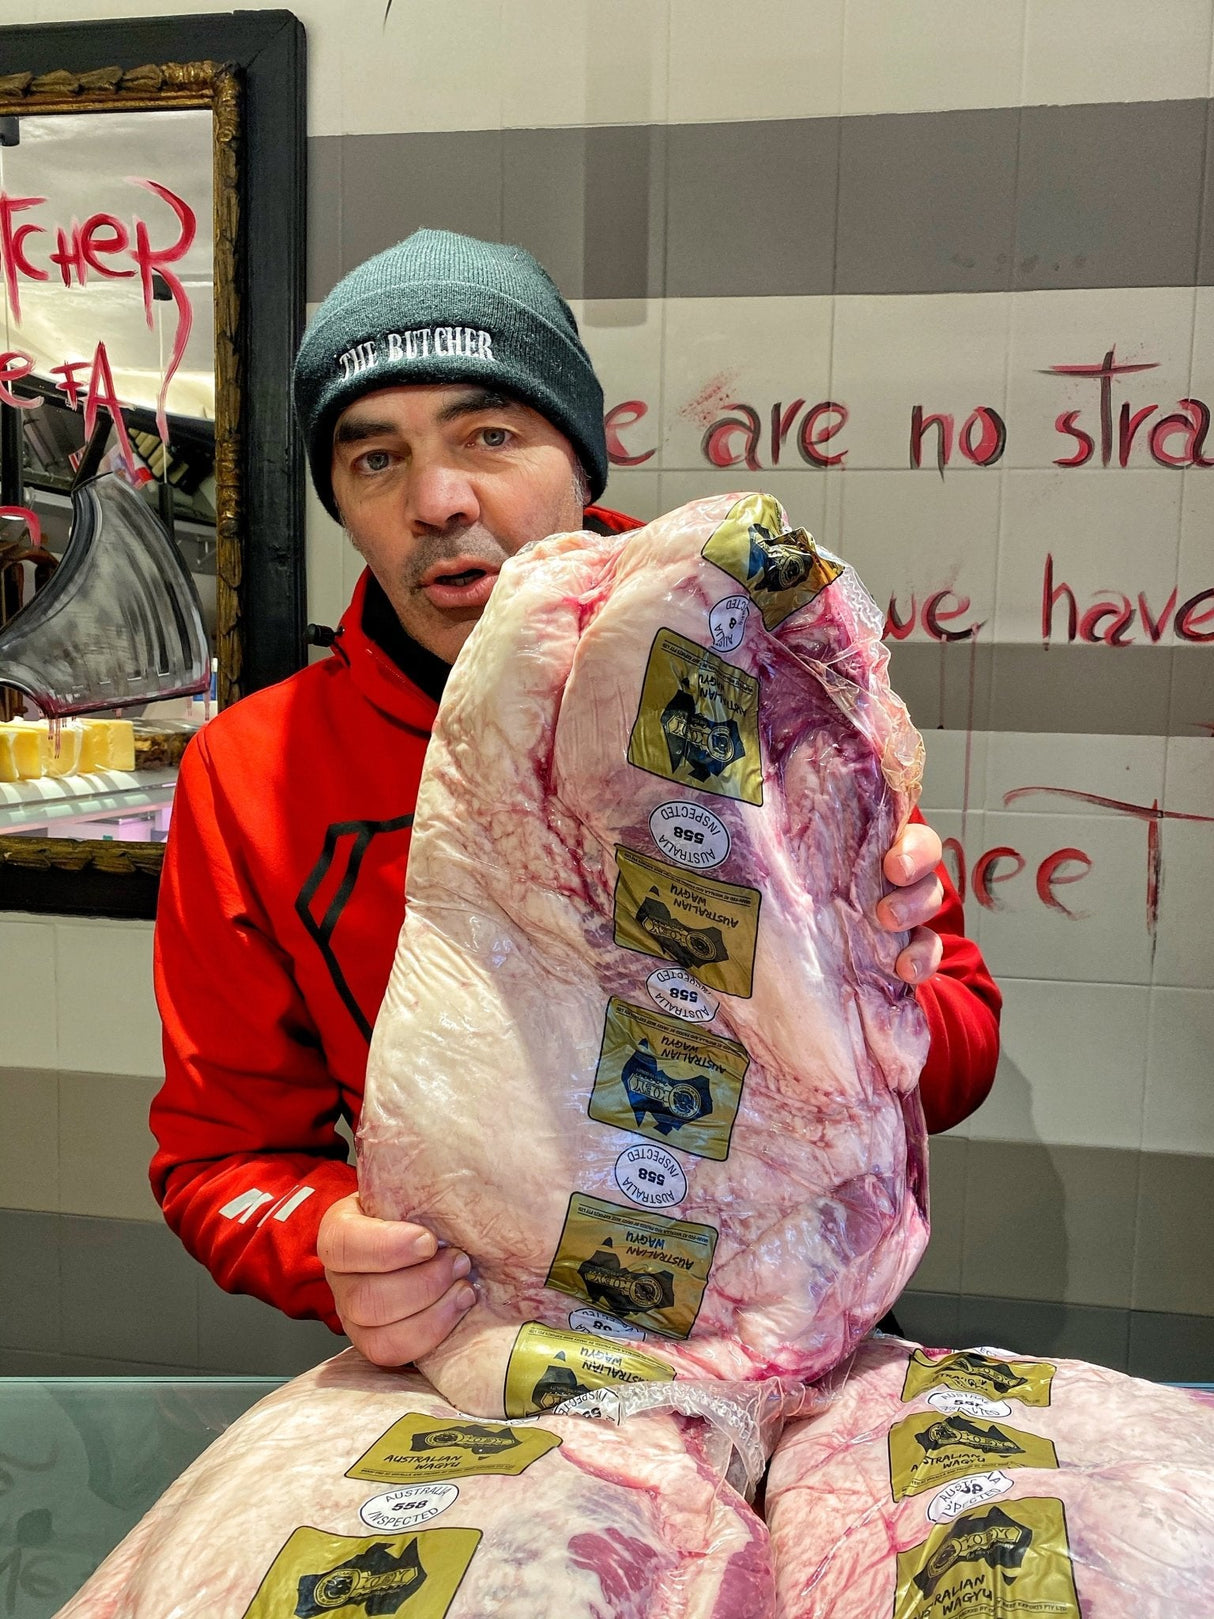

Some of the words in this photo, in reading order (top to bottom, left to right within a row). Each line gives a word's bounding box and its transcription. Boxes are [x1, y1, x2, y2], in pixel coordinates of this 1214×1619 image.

[339, 341, 379, 382] THE
[387, 326, 495, 362] BUTCHER
[604, 400, 662, 467] e
[701, 398, 849, 471] are
[909, 403, 1007, 481] no
[1042, 552, 1214, 650] have
[660, 806, 721, 836] INSPECTED
[673, 826, 705, 845] 558
[658, 834, 716, 864] AUSTRALIA
[670, 883, 707, 907] WAGYU
[673, 899, 739, 928] AUSTRALIAN
[669, 986, 698, 1003] 558
[653, 992, 709, 1021] AUSTRALIA
[660, 1035, 701, 1052] WAGYU
[661, 1047, 727, 1074] AUSTRALIAN
[627, 1148, 680, 1178] INSPECTED
[638, 1167, 666, 1186] 558
[622, 1176, 675, 1205] AUSTRALIA
[625, 1231, 666, 1249] WAGYU
[626, 1246, 695, 1270] AUSTRALIAN
[580, 1346, 623, 1366] WAGYU
[581, 1360, 649, 1383] STRALIAN
[383, 1454, 463, 1464] AUSTRALIAN
[414, 1461, 461, 1470] WAGYU
[910, 1452, 981, 1472] ASTRALIAN
[942, 1457, 986, 1469] WAGYU
[385, 1484, 453, 1503] AUSTRALIA
[367, 1507, 439, 1527] INSPECTED
[391, 1500, 429, 1511] 558
[942, 1588, 993, 1617] WAGYU
